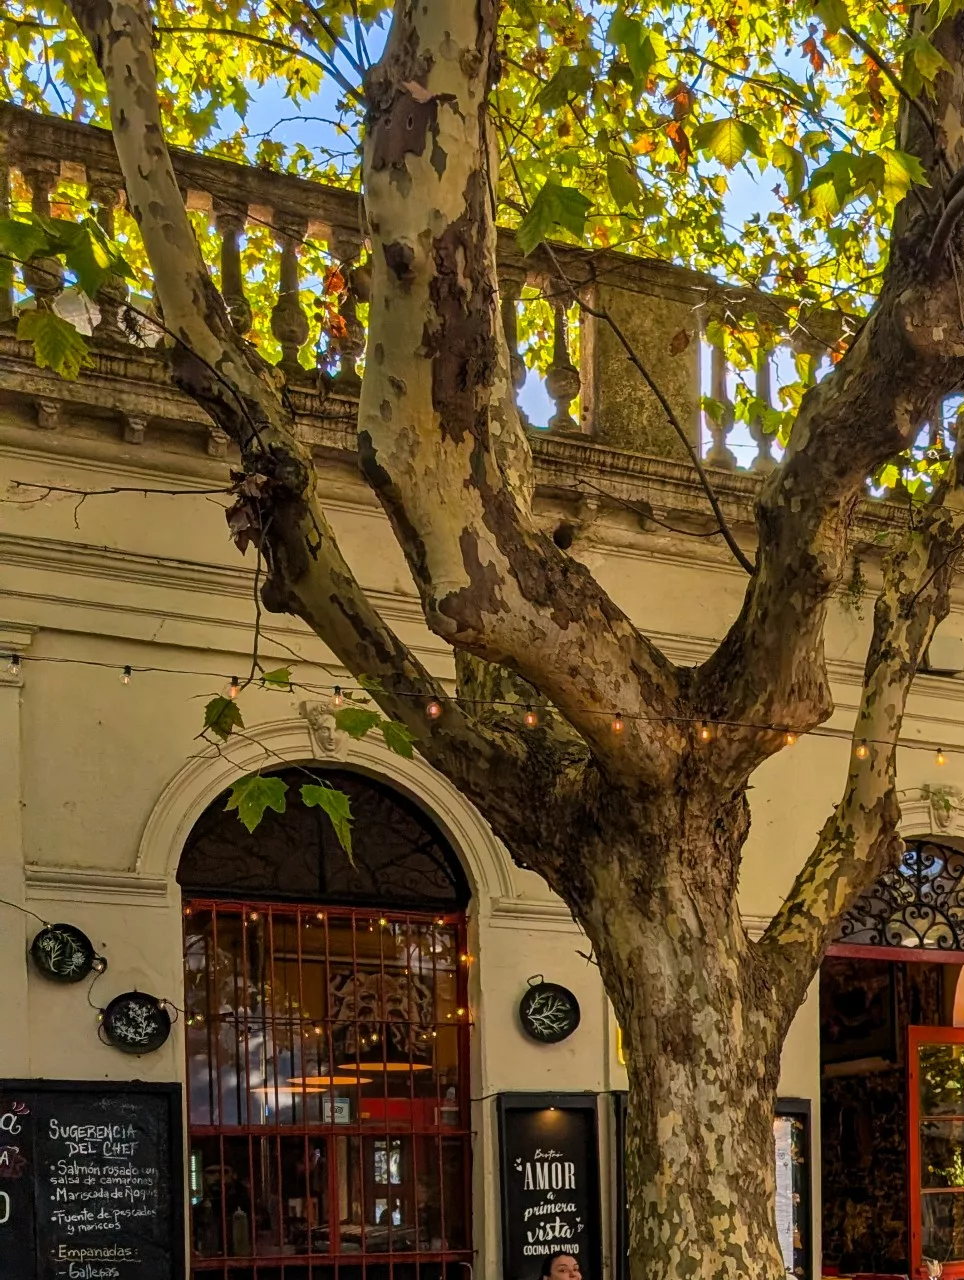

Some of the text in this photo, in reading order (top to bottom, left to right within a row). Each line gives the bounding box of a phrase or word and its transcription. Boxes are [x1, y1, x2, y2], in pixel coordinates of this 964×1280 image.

[49, 1118, 137, 1142] SUGERENCIA
[65, 1141, 139, 1158] DEL CHEF
[57, 1159, 101, 1176] Salmón
[102, 1161, 139, 1177] rosado
[523, 1161, 576, 1191] AMOR
[50, 1174, 154, 1186] salsa de camarones
[56, 1187, 110, 1203] Mariscada
[110, 1187, 124, 1199] de
[546, 1191, 556, 1201] a
[53, 1205, 157, 1225] Fuente de pescados
[524, 1201, 577, 1222] primera
[67, 1221, 121, 1236] y mariscos
[526, 1215, 575, 1244] vista
[523, 1244, 549, 1256] COCINA
[561, 1243, 580, 1254] VIVO
